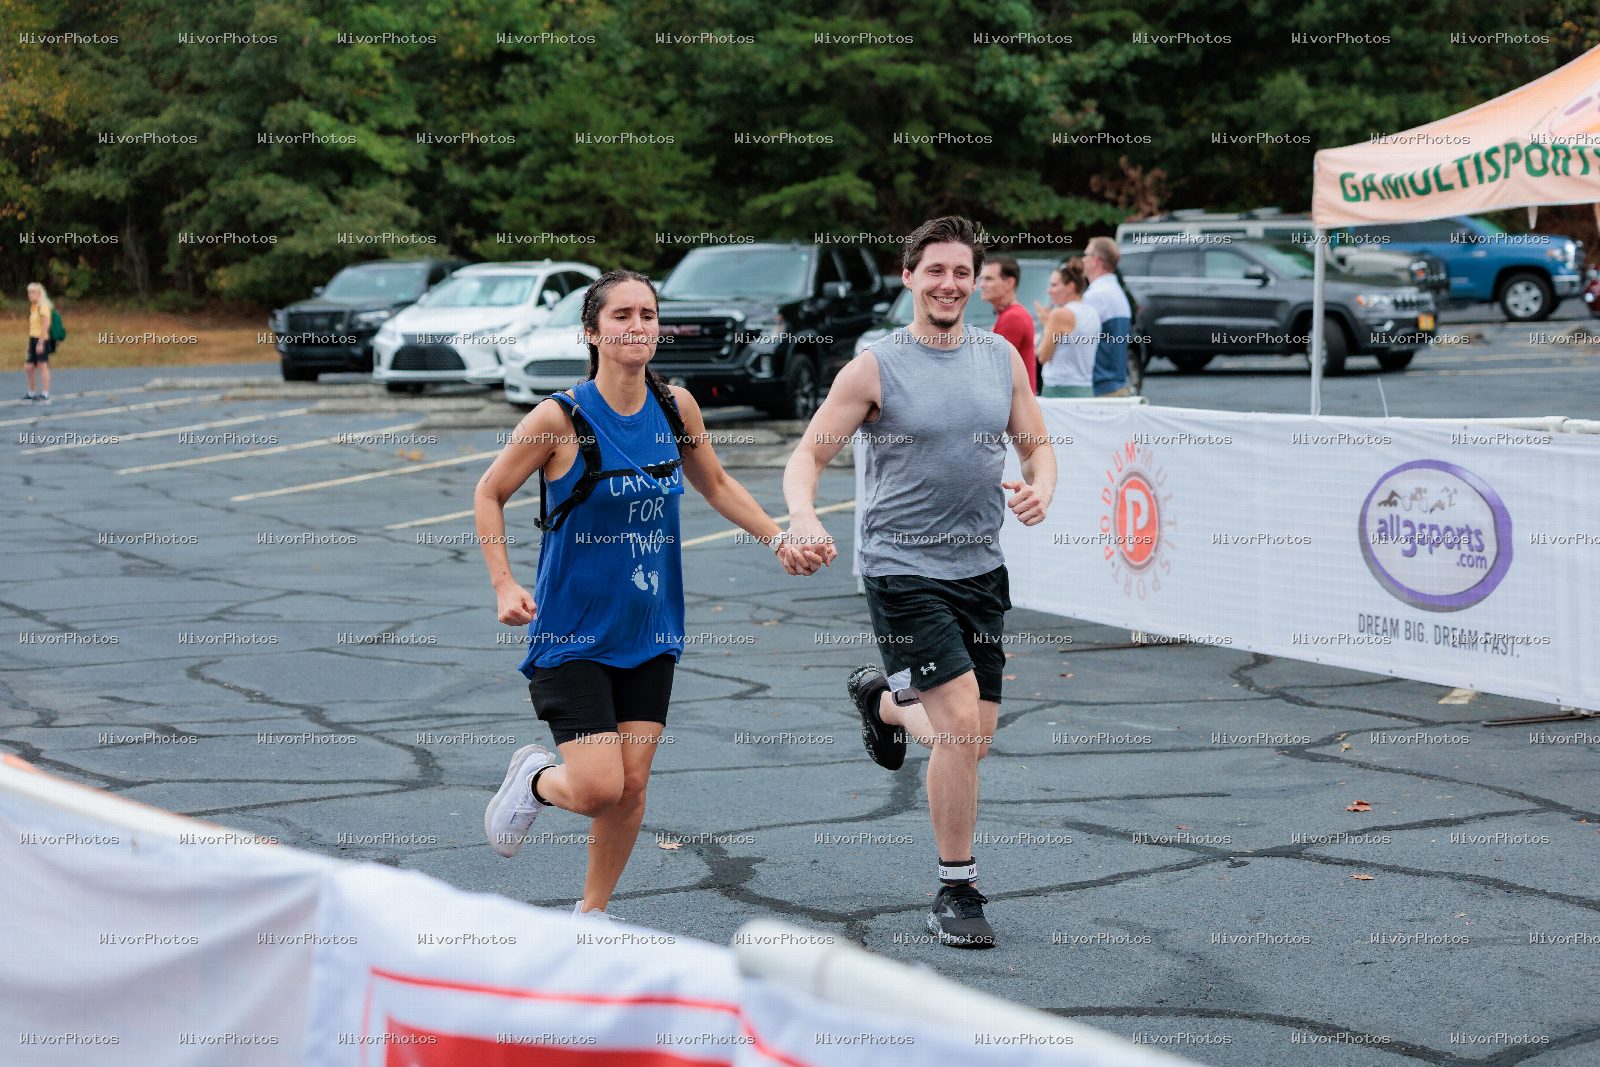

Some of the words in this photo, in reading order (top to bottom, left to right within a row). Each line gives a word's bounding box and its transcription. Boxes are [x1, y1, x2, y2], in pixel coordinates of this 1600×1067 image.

[628, 496, 665, 523] FOR
[1125, 488, 1150, 553] P
[627, 528, 663, 558] TWO
[1456, 553, 1488, 570] .com
[1358, 613, 1400, 639] DREAM
[1404, 620, 1429, 644] BIG.
[1434, 625, 1479, 652] DREAM
[1483, 632, 1520, 658] FAST.
